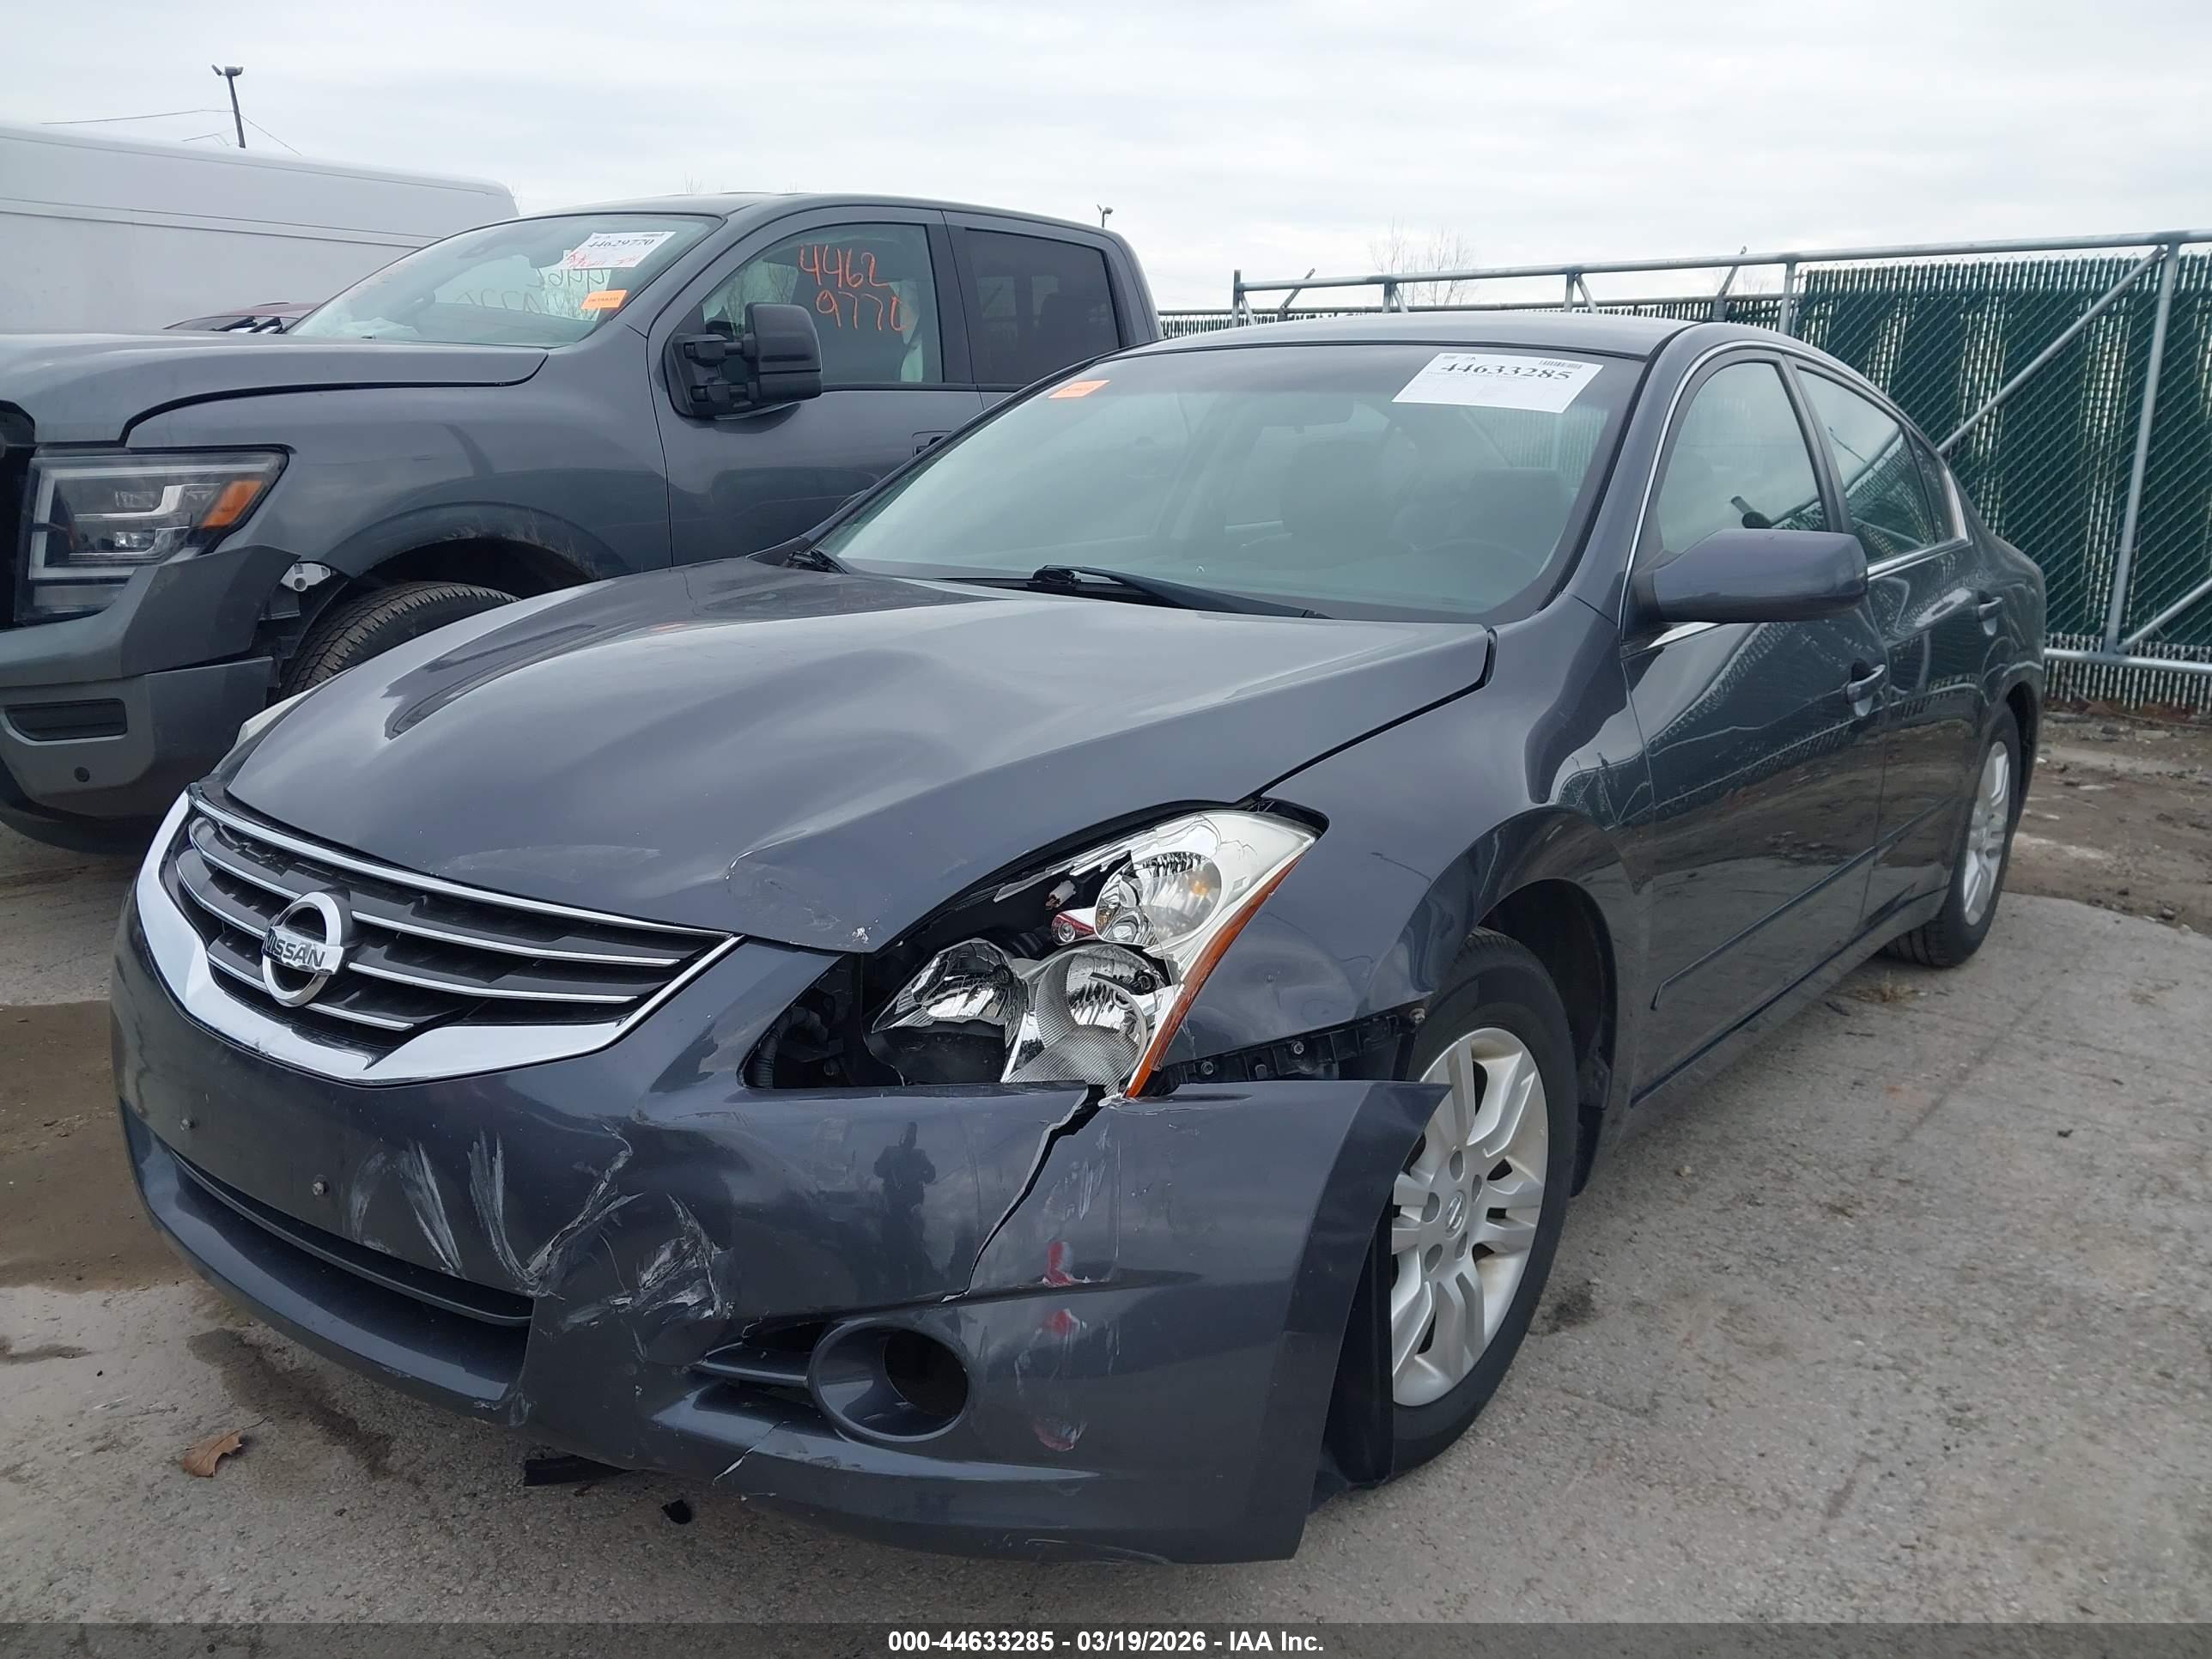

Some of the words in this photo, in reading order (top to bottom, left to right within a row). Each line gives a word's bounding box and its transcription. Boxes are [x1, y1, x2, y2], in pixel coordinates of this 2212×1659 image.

[799, 244, 890, 289] 4462
[1441, 362, 1574, 380] 44633285
[264, 927, 326, 968] NISSAN
